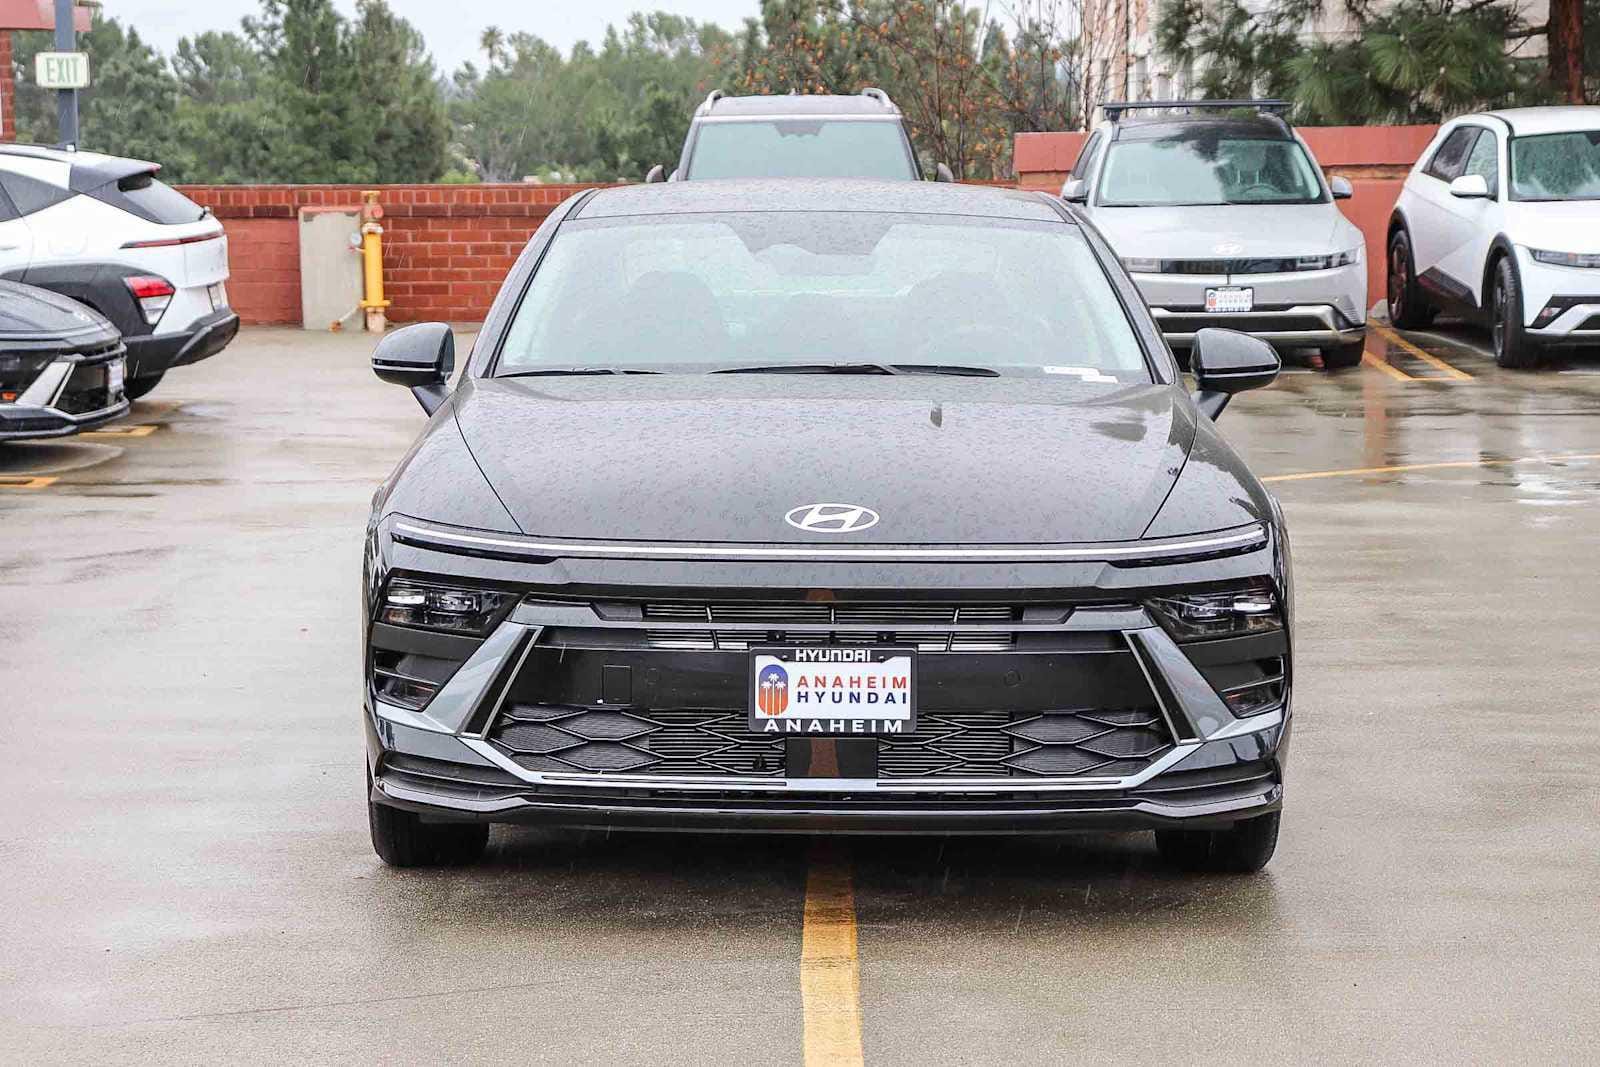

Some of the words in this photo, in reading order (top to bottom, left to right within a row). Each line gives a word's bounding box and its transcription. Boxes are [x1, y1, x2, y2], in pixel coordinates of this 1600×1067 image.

[45, 57, 80, 83] EXIT
[795, 649, 871, 662] HYUNDAI
[797, 676, 907, 689] ANAHEIM
[797, 691, 907, 704] HYUNDAI
[764, 719, 902, 733] ANAHEIM
